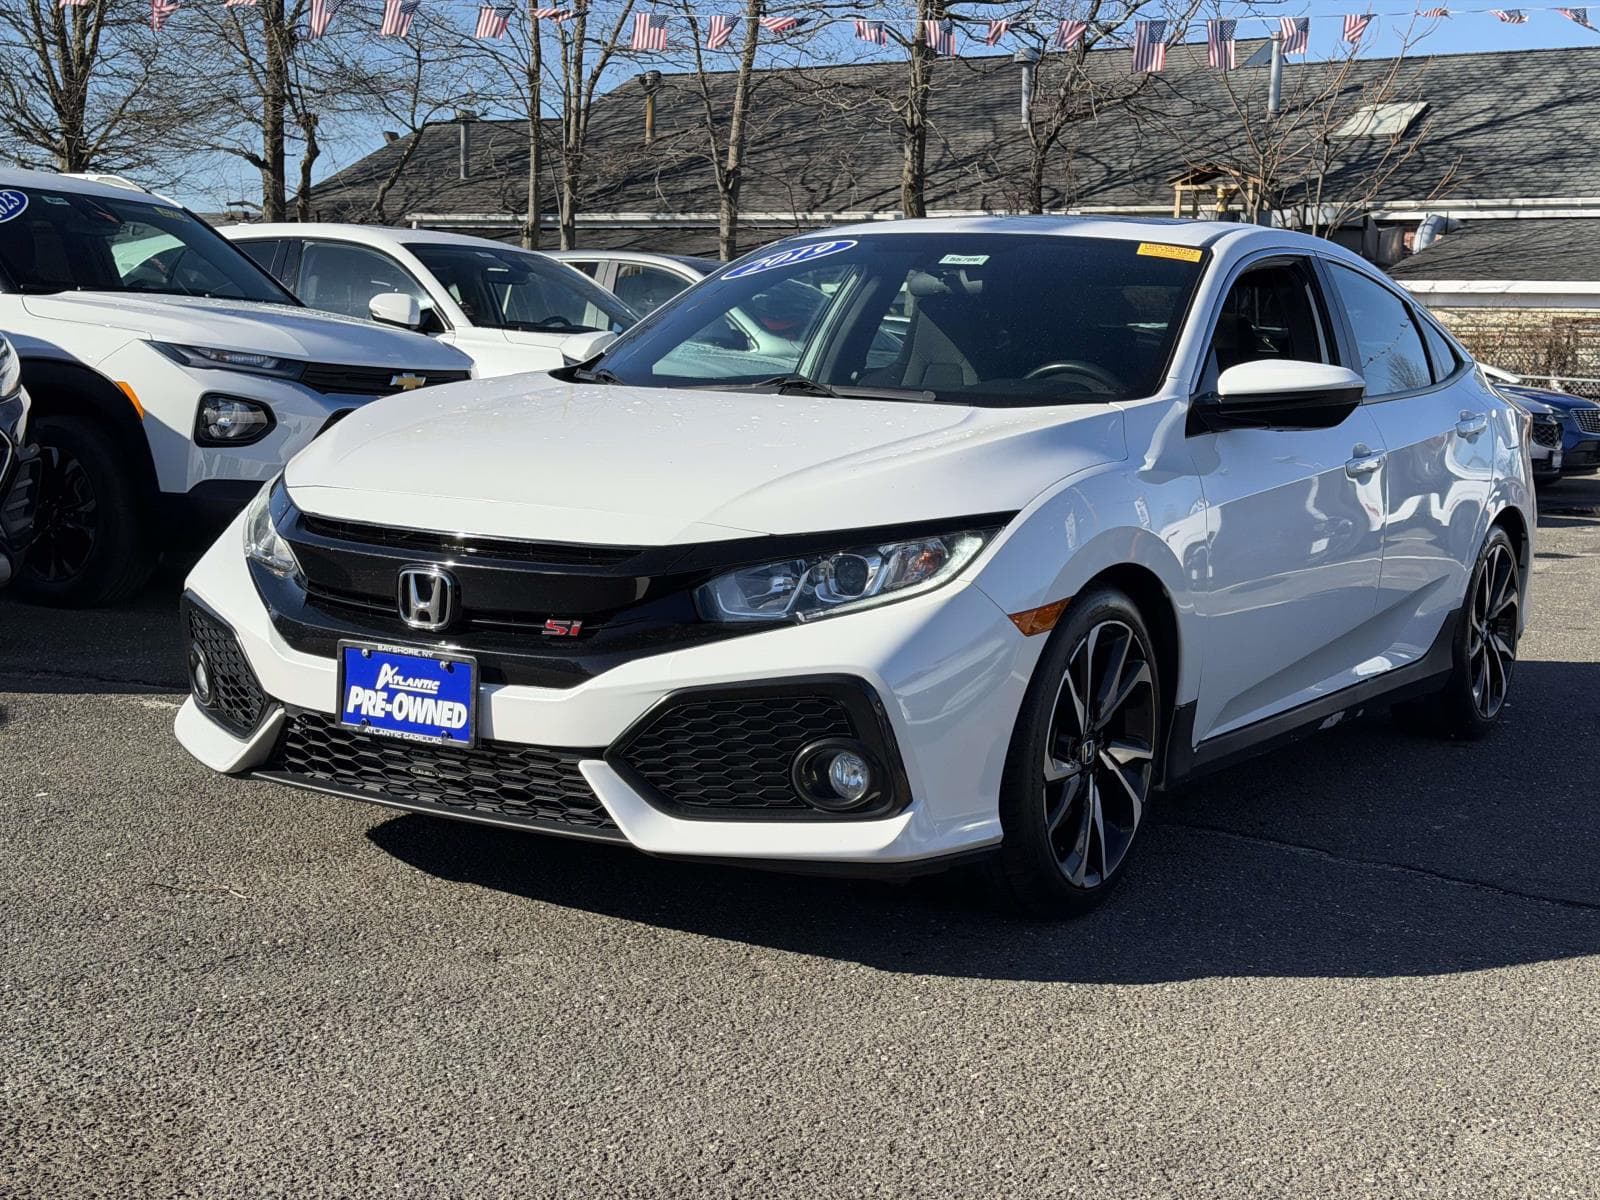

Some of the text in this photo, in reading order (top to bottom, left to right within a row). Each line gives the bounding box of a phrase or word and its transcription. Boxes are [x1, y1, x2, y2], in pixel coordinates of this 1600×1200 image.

[375, 662, 441, 691] ATLANTIC
[346, 685, 468, 729] PRE-OWNED
[364, 725, 402, 739] ATLANTIC
